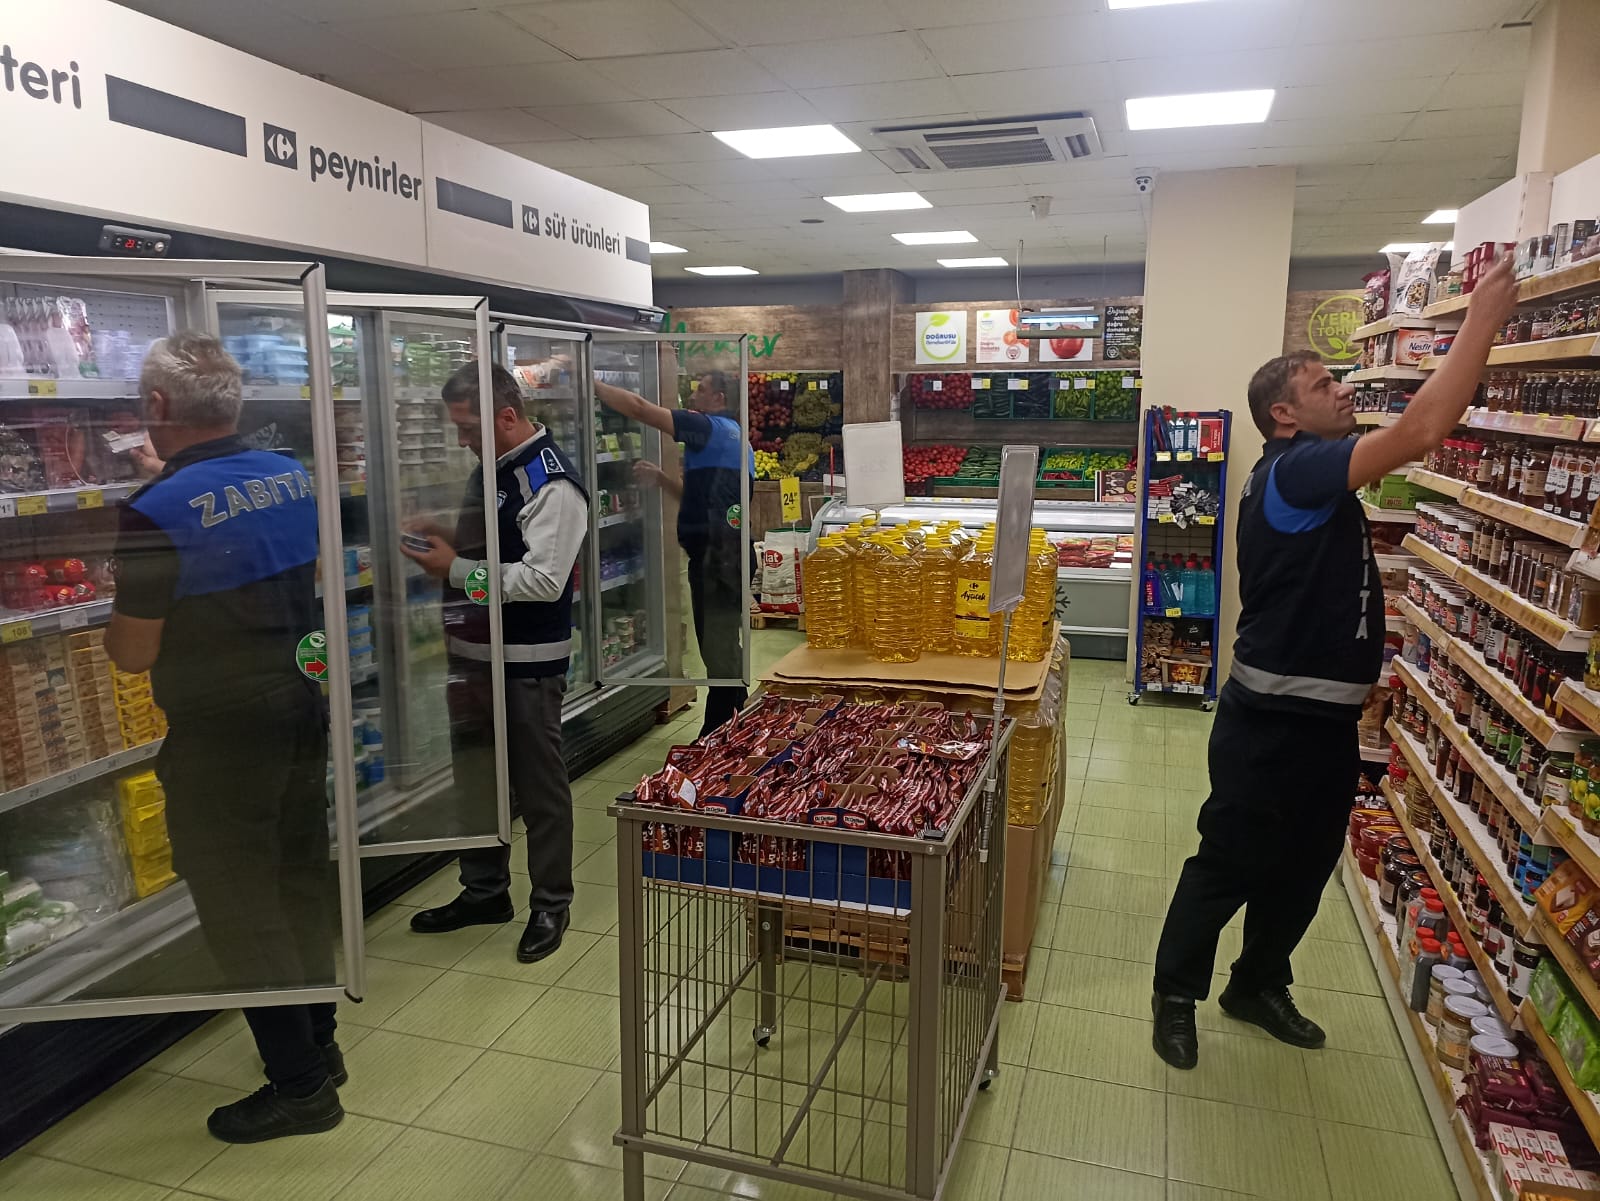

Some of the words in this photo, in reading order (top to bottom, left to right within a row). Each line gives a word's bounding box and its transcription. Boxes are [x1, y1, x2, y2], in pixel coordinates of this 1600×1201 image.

[310, 145, 422, 200] peynirler
[545, 212, 567, 240] süt
[571, 218, 620, 255] ürünleri
[1316, 312, 1361, 328] YERL
[1316, 326, 1355, 337] TOHU
[1409, 342, 1431, 351] Nesfit
